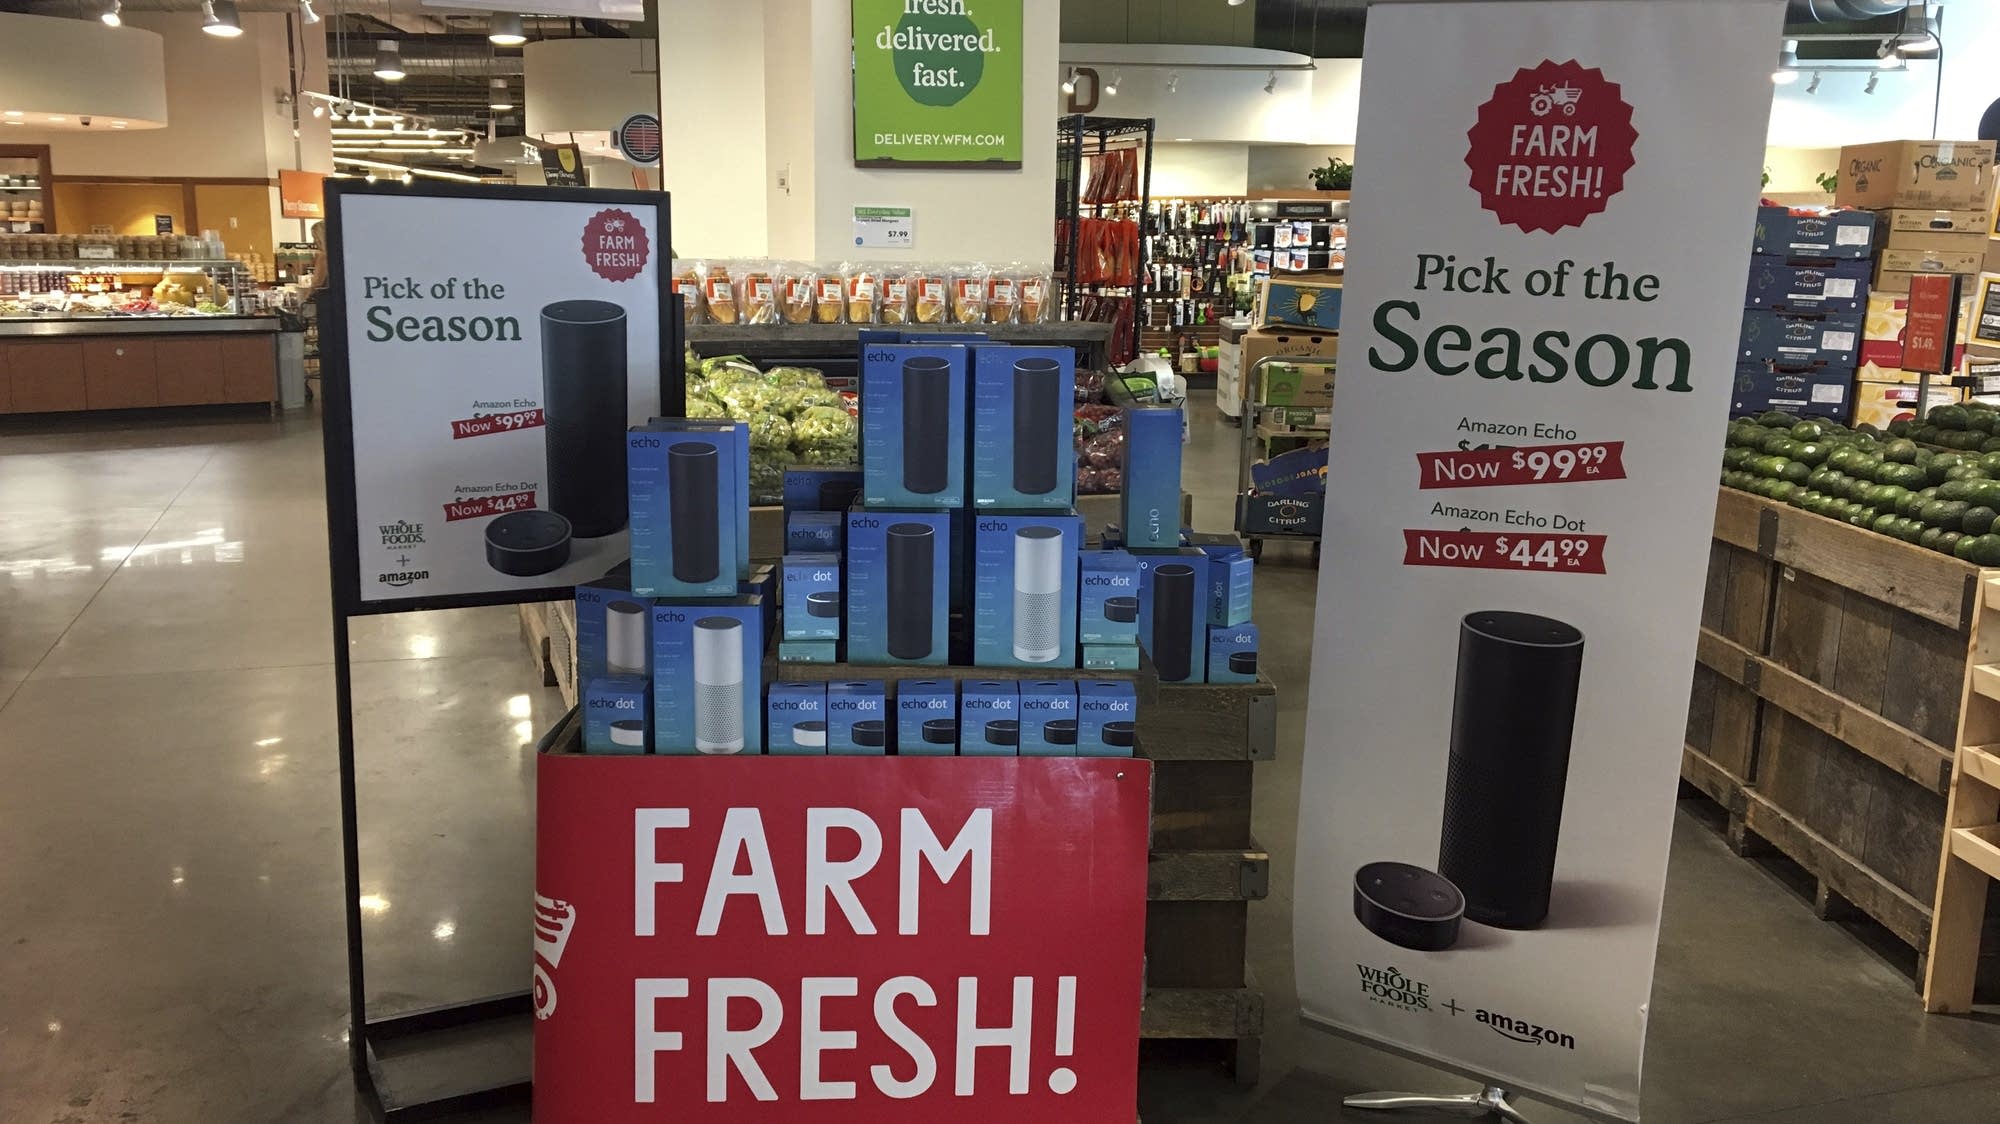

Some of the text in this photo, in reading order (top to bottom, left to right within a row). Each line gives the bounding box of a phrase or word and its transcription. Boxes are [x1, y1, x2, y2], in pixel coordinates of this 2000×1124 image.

[876, 25, 1001, 52] delivered.
[913, 62, 965, 87] fast.
[874, 133, 1005, 146] DELIVERY.WFM.COM
[1510, 124, 1598, 157] FARM
[1495, 164, 1603, 198] FRESH!
[599, 235, 635, 250] FARM
[596, 252, 640, 267] FRESH!
[1413, 254, 1660, 302] Pick of the
[363, 276, 505, 299] Pick of the
[366, 305, 522, 342] Season
[1368, 299, 1693, 393] Season
[867, 350, 896, 362] echo
[473, 399, 536, 408] Amazon Echo
[460, 422, 491, 434] Now
[1457, 417, 1577, 441] Amazon Echo
[631, 437, 661, 449] echo
[1435, 458, 1500, 481] Now
[1586, 466, 1600, 474] EA
[454, 482, 538, 493] Amazon Echo Dot
[451, 505, 483, 517] Now
[1267, 499, 1309, 508] DARLING
[851, 516, 880, 529] echo
[979, 520, 1008, 532] echo
[1269, 516, 1307, 525] CITRUS
[1431, 502, 1586, 532] Amazon Echo Dot
[379, 521, 424, 535] WHOLE
[382, 533, 423, 545] FOODS
[1419, 536, 1483, 560] Now
[1567, 558, 1580, 566] EA
[379, 570, 429, 583] amazon
[656, 611, 686, 623] echo
[635, 807, 993, 936] FARM
[1357, 963, 1429, 998] WHOLE
[1361, 979, 1429, 1010] FOODS
[1369, 996, 1418, 1014] MARKET
[1475, 1007, 1575, 1050] amazon
[634, 975, 1077, 1103] FRESH!
